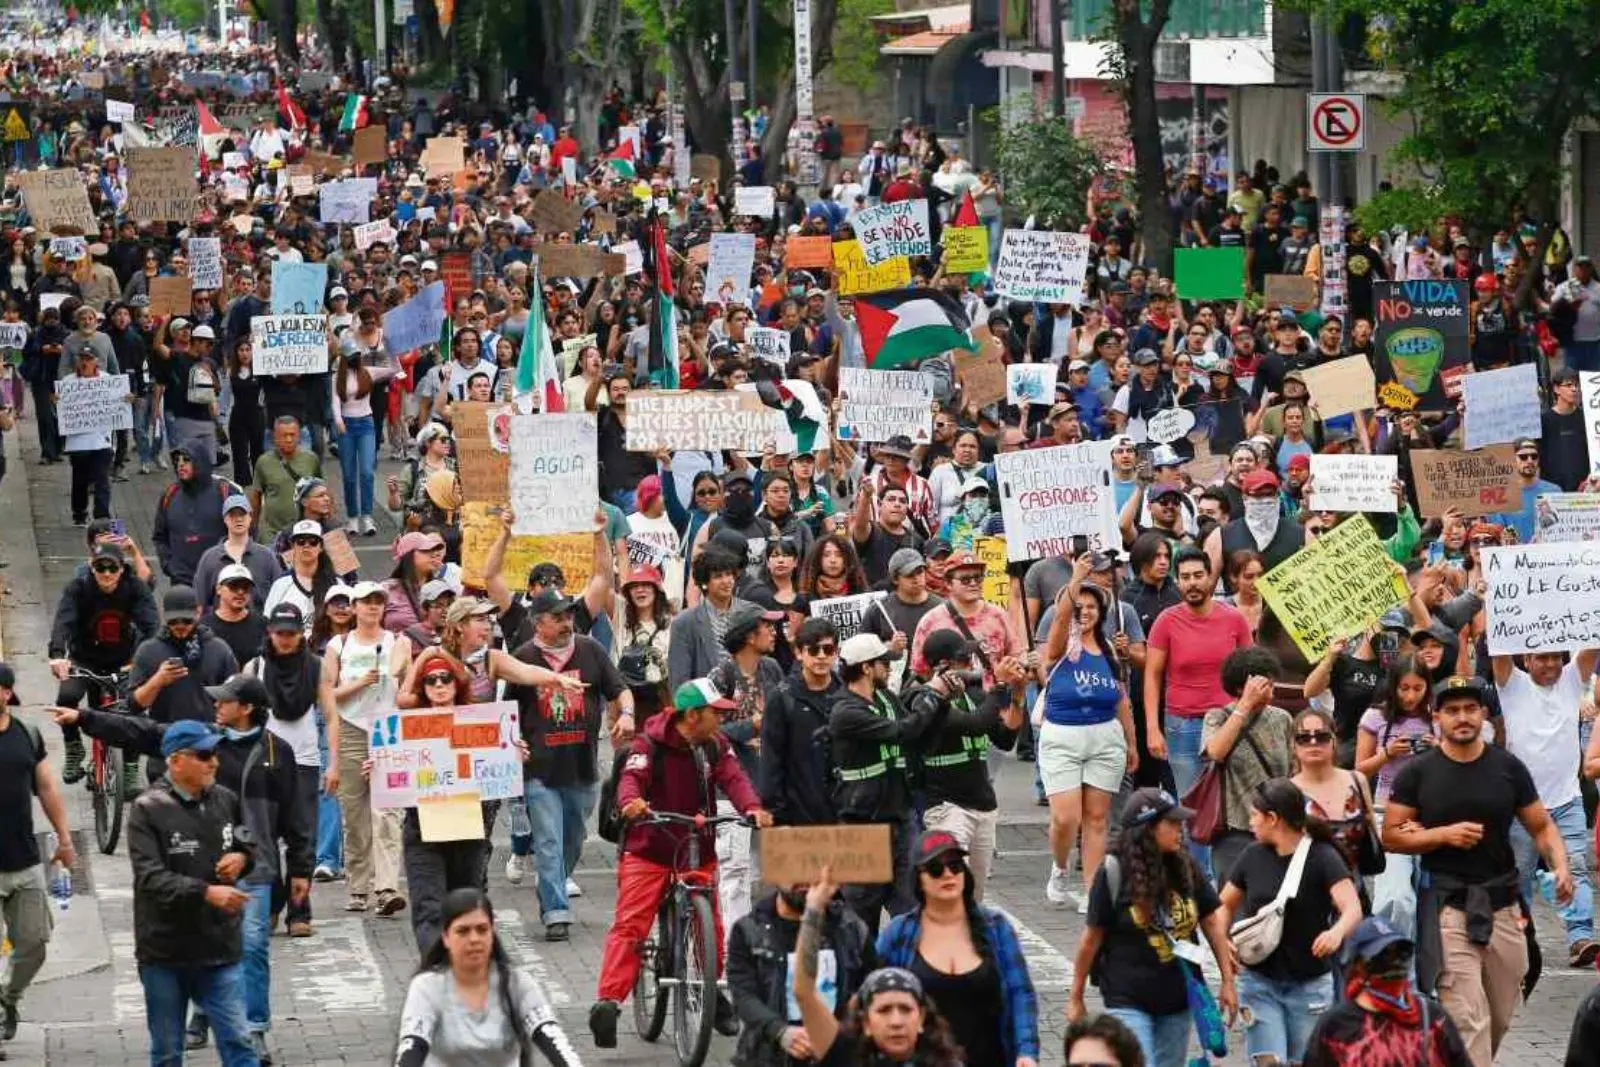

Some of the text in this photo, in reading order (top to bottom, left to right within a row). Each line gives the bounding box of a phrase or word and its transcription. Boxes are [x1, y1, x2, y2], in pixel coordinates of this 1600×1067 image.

[864, 228, 879, 244] SE
[1404, 280, 1458, 302] VIDA
[1379, 299, 1411, 321] NO
[1426, 305, 1462, 317] vende
[267, 331, 324, 347] DERECHO
[628, 396, 662, 411] THE
[627, 432, 658, 449] POR
[533, 455, 584, 475] AGUA
[1019, 485, 1099, 510] CABRONES
[1479, 487, 1507, 505] PAZ
[1490, 553, 1500, 572] A
[1494, 582, 1519, 600] NO
[1527, 577, 1550, 595] LE
